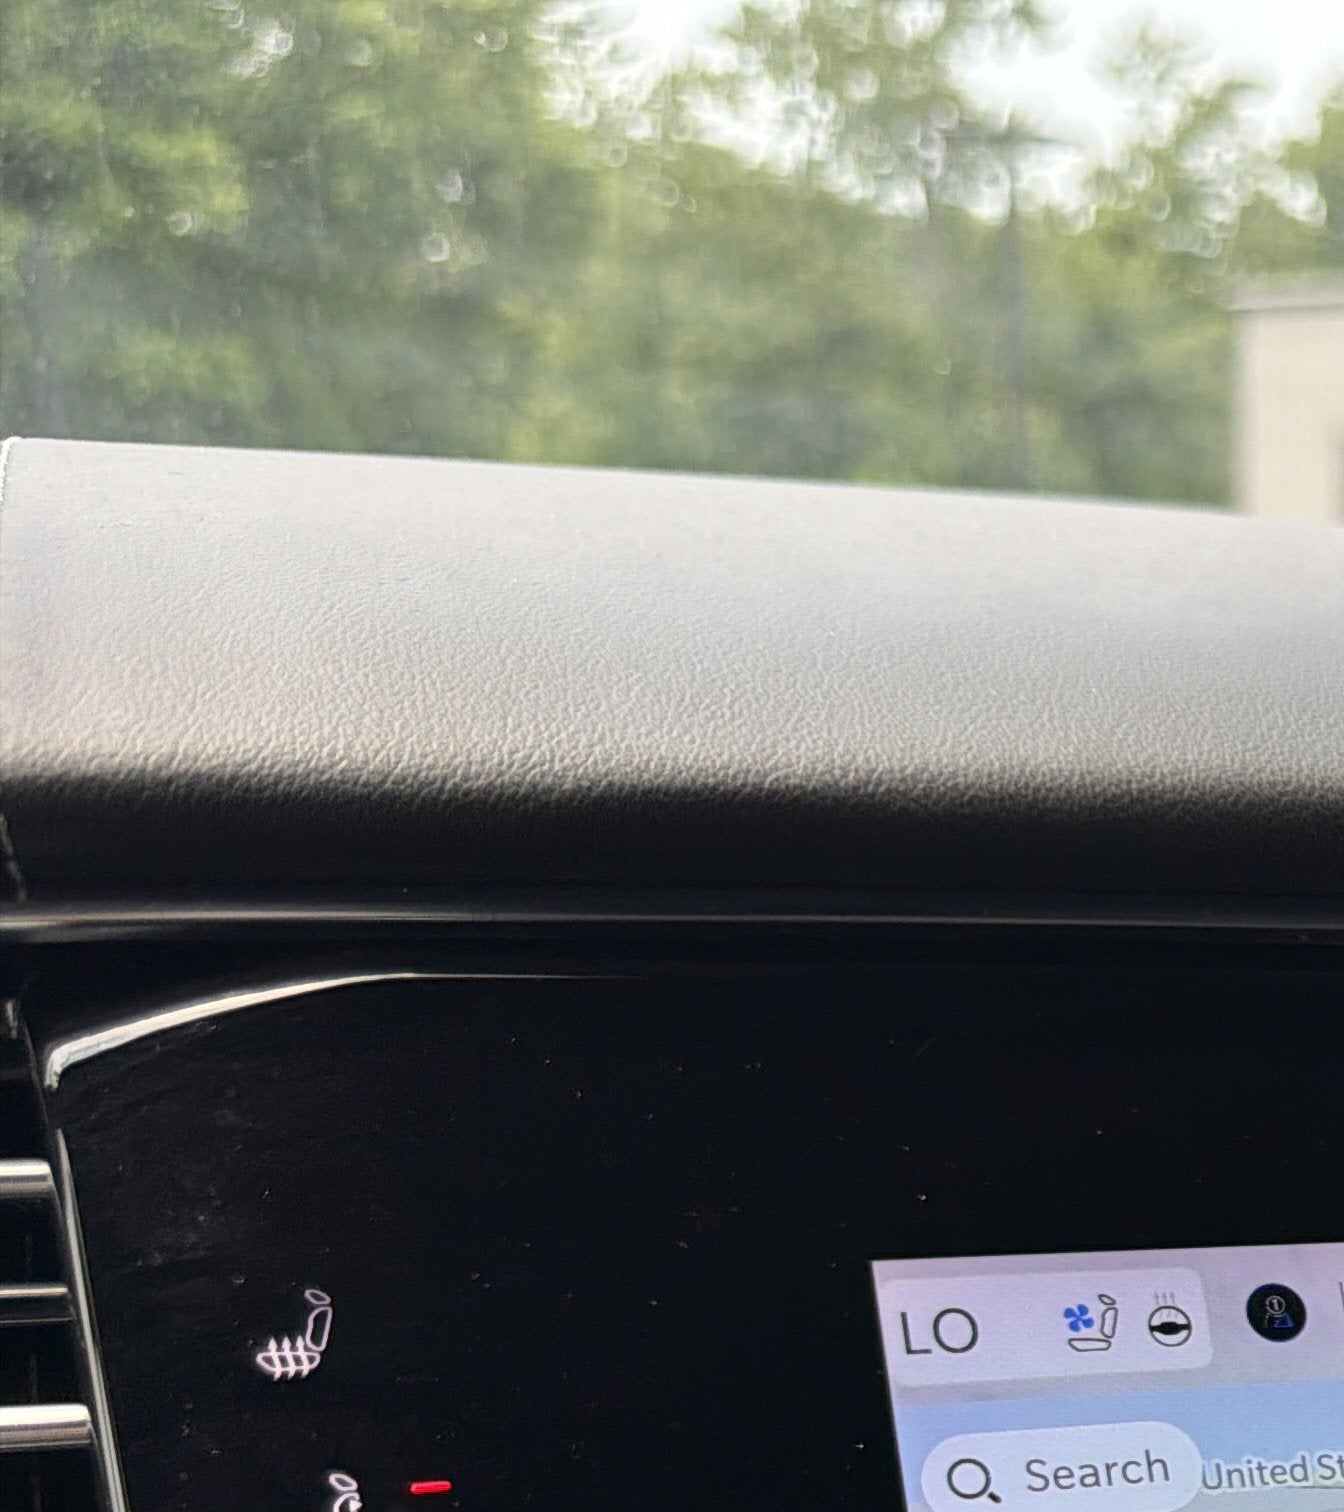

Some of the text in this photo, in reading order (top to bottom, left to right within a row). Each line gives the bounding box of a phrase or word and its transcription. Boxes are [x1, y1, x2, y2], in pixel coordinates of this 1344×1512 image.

[901, 1307, 978, 1354] LO
[1026, 1450, 1170, 1492] Search
[1203, 1458, 1308, 1490] United
